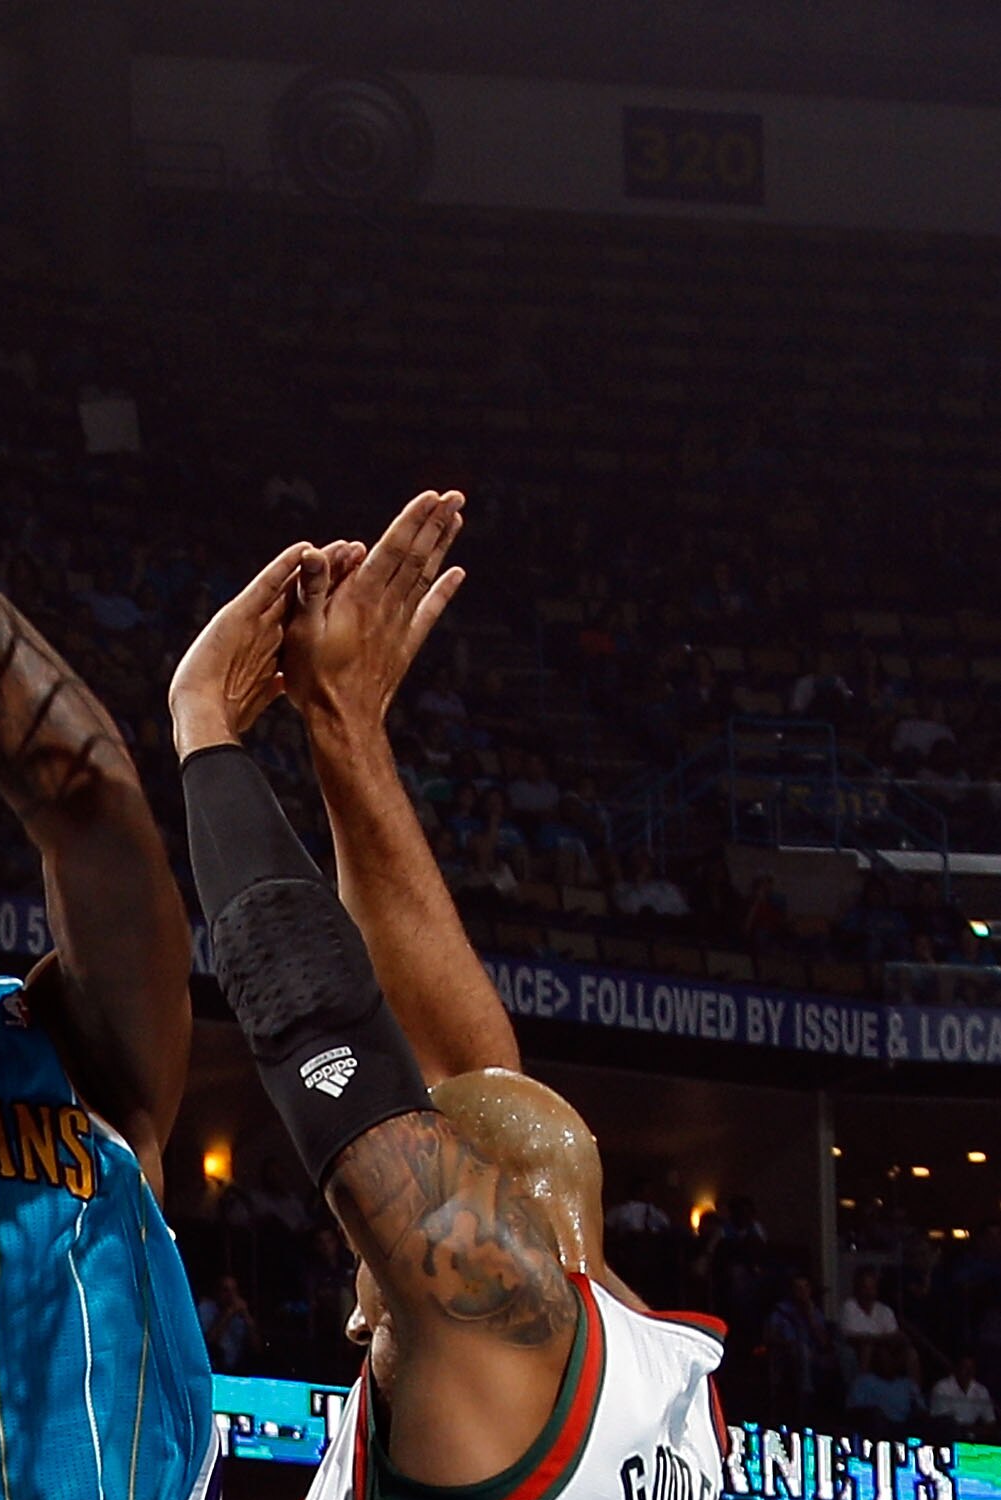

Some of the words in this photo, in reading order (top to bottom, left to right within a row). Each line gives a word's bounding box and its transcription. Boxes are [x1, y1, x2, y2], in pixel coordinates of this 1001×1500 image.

[631, 126, 757, 186] 320
[487, 961, 571, 1018] ACE>
[580, 974, 738, 1040] FOLLOWED
[746, 996, 785, 1045] BY
[794, 1003, 879, 1057] ISSUE
[886, 1011, 908, 1058] &
